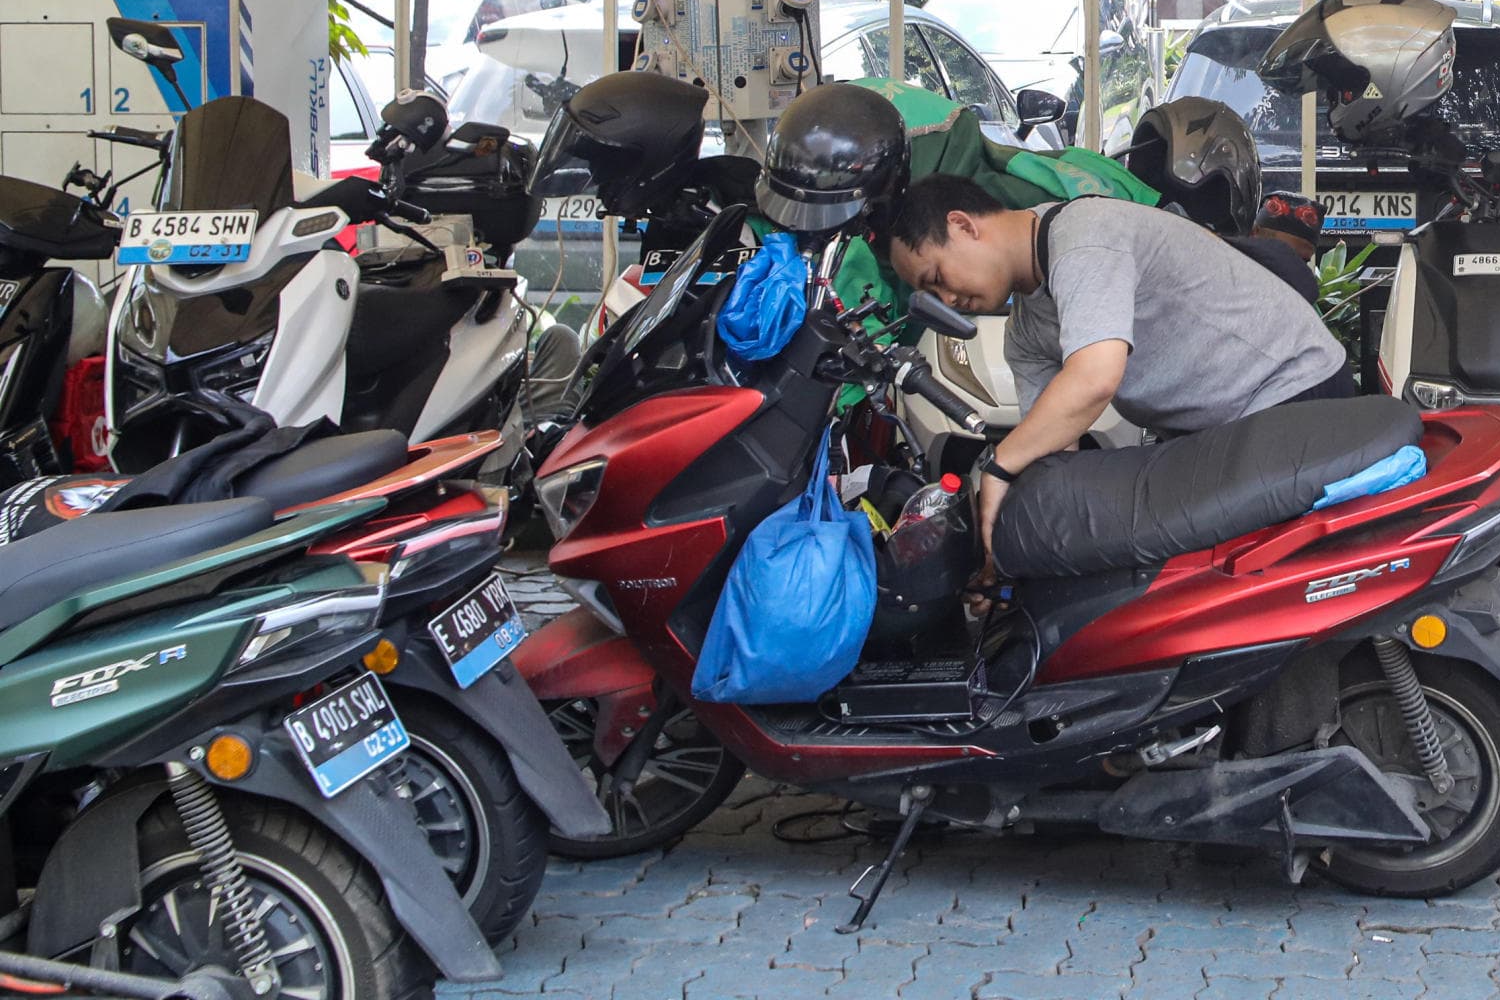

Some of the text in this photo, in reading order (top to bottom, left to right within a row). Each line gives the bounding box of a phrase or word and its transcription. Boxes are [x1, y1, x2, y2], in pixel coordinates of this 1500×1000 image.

[317, 57, 326, 108] PLN
[80, 88, 92, 112] 1
[114, 88, 130, 112] 2
[115, 197, 129, 216] 4
[1317, 194, 1412, 216] 914 KNS
[130, 217, 142, 238] B
[152, 215, 201, 237] 4584
[649, 252, 661, 266] B
[1458, 257, 1465, 265] B
[1472, 256, 1498, 265] 4866
[1305, 563, 1388, 593] FOX
[434, 624, 455, 653] E
[451, 599, 488, 639] 4680
[50, 651, 158, 696] FOX
[292, 720, 315, 753] B
[312, 699, 358, 740] 4901
